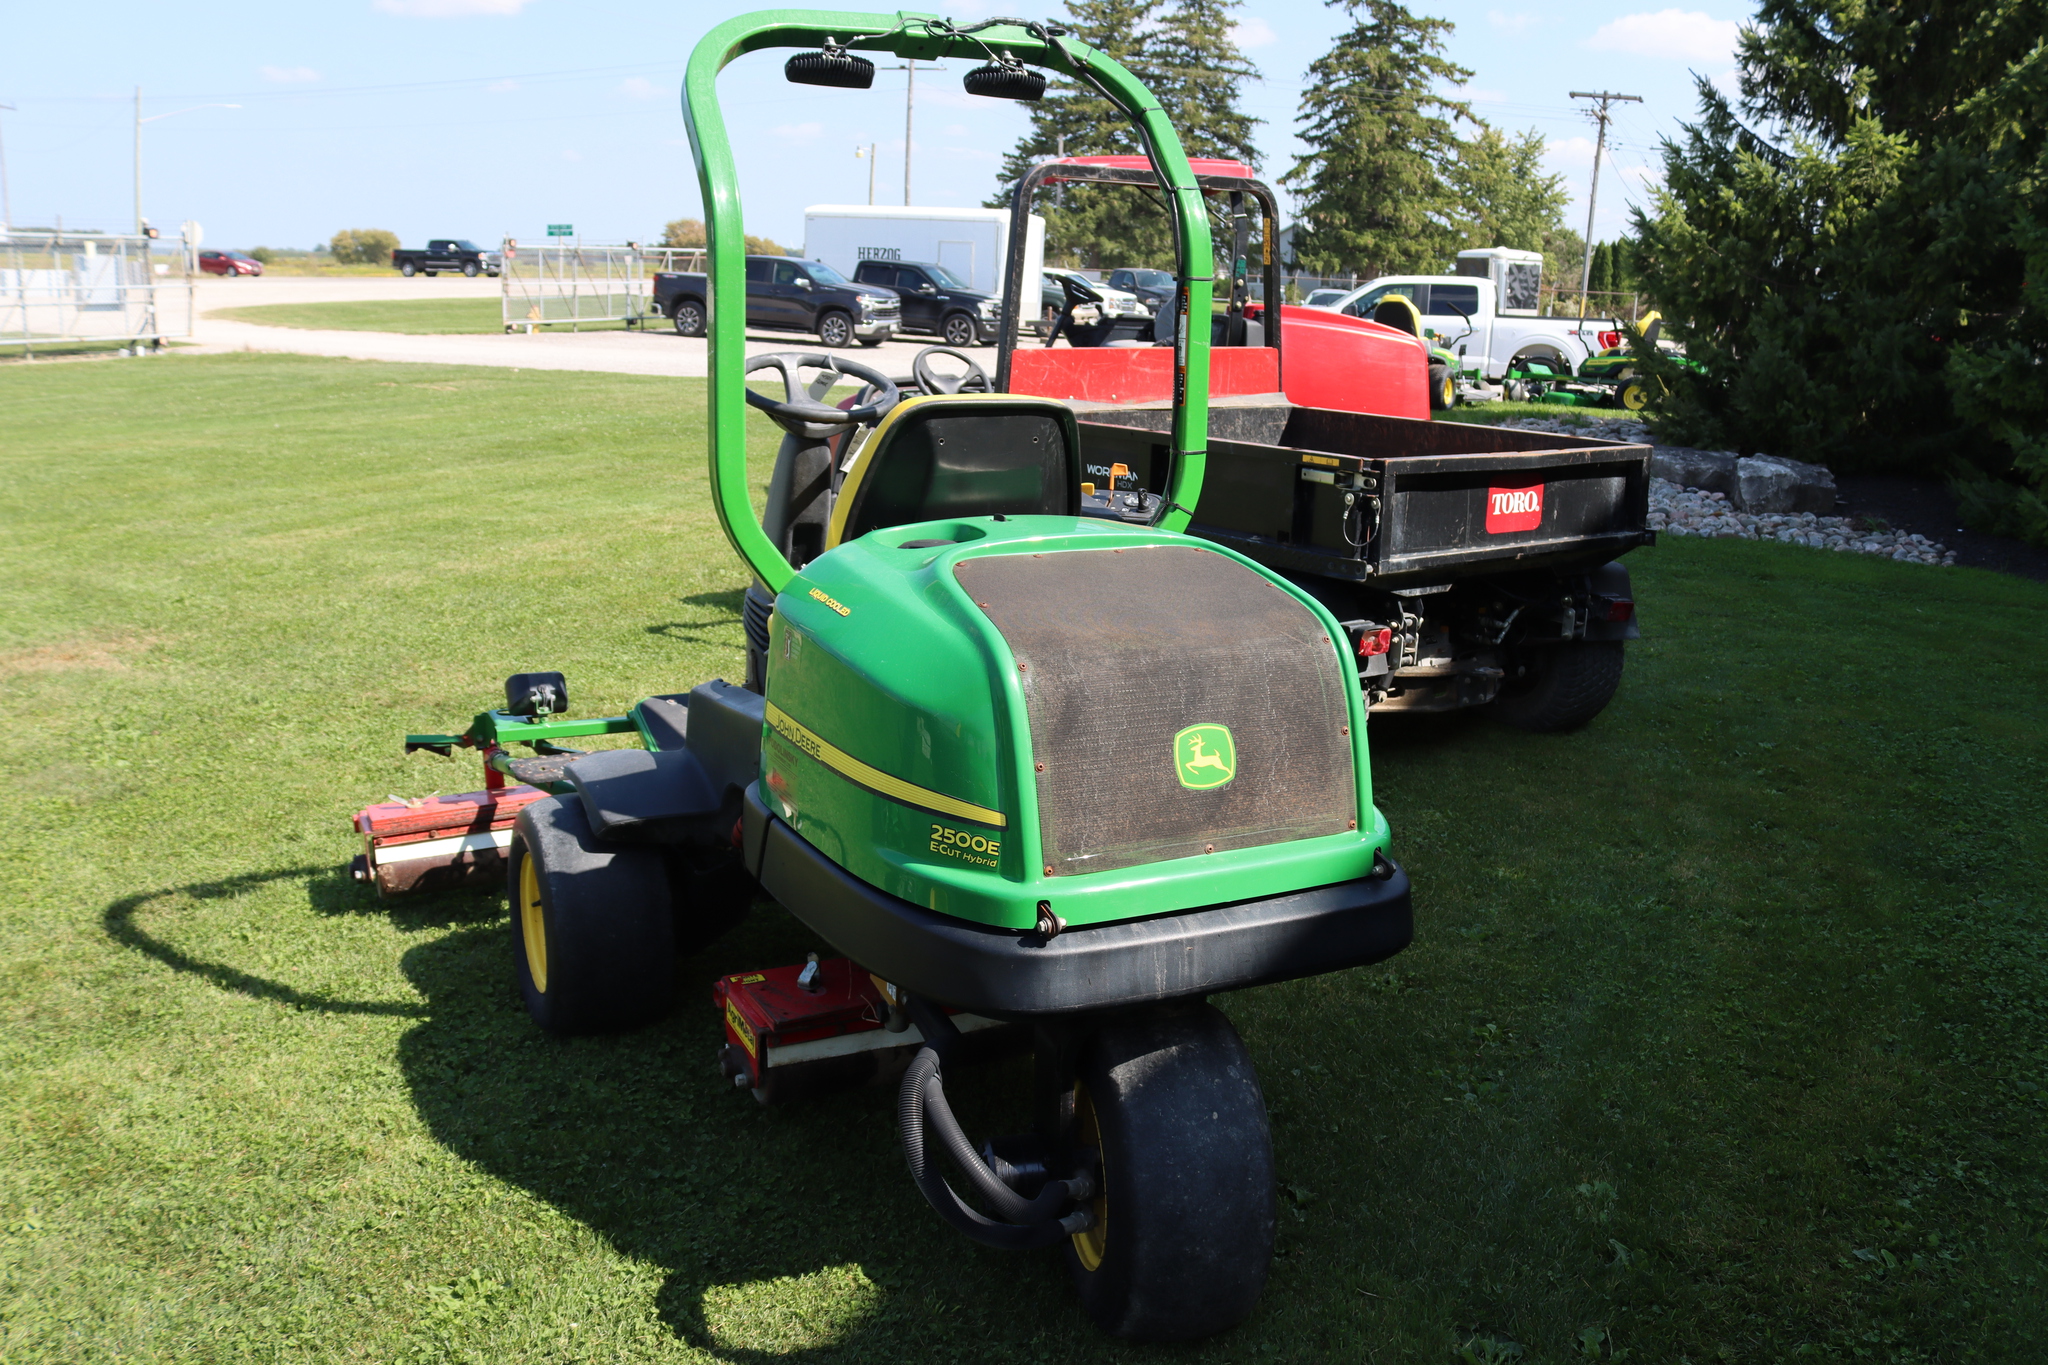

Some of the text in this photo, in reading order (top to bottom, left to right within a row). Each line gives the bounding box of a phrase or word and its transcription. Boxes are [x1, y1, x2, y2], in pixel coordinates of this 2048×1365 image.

[858, 246, 901, 261] HERZOG
[1086, 463, 1139, 482] WORAN
[1116, 480, 1133, 490] HDX
[808, 587, 851, 617] LIQUID COOLED
[775, 714, 822, 760] JOHN DEERE
[930, 823, 1001, 856] 2500E
[962, 852, 998, 868] Hybrid
